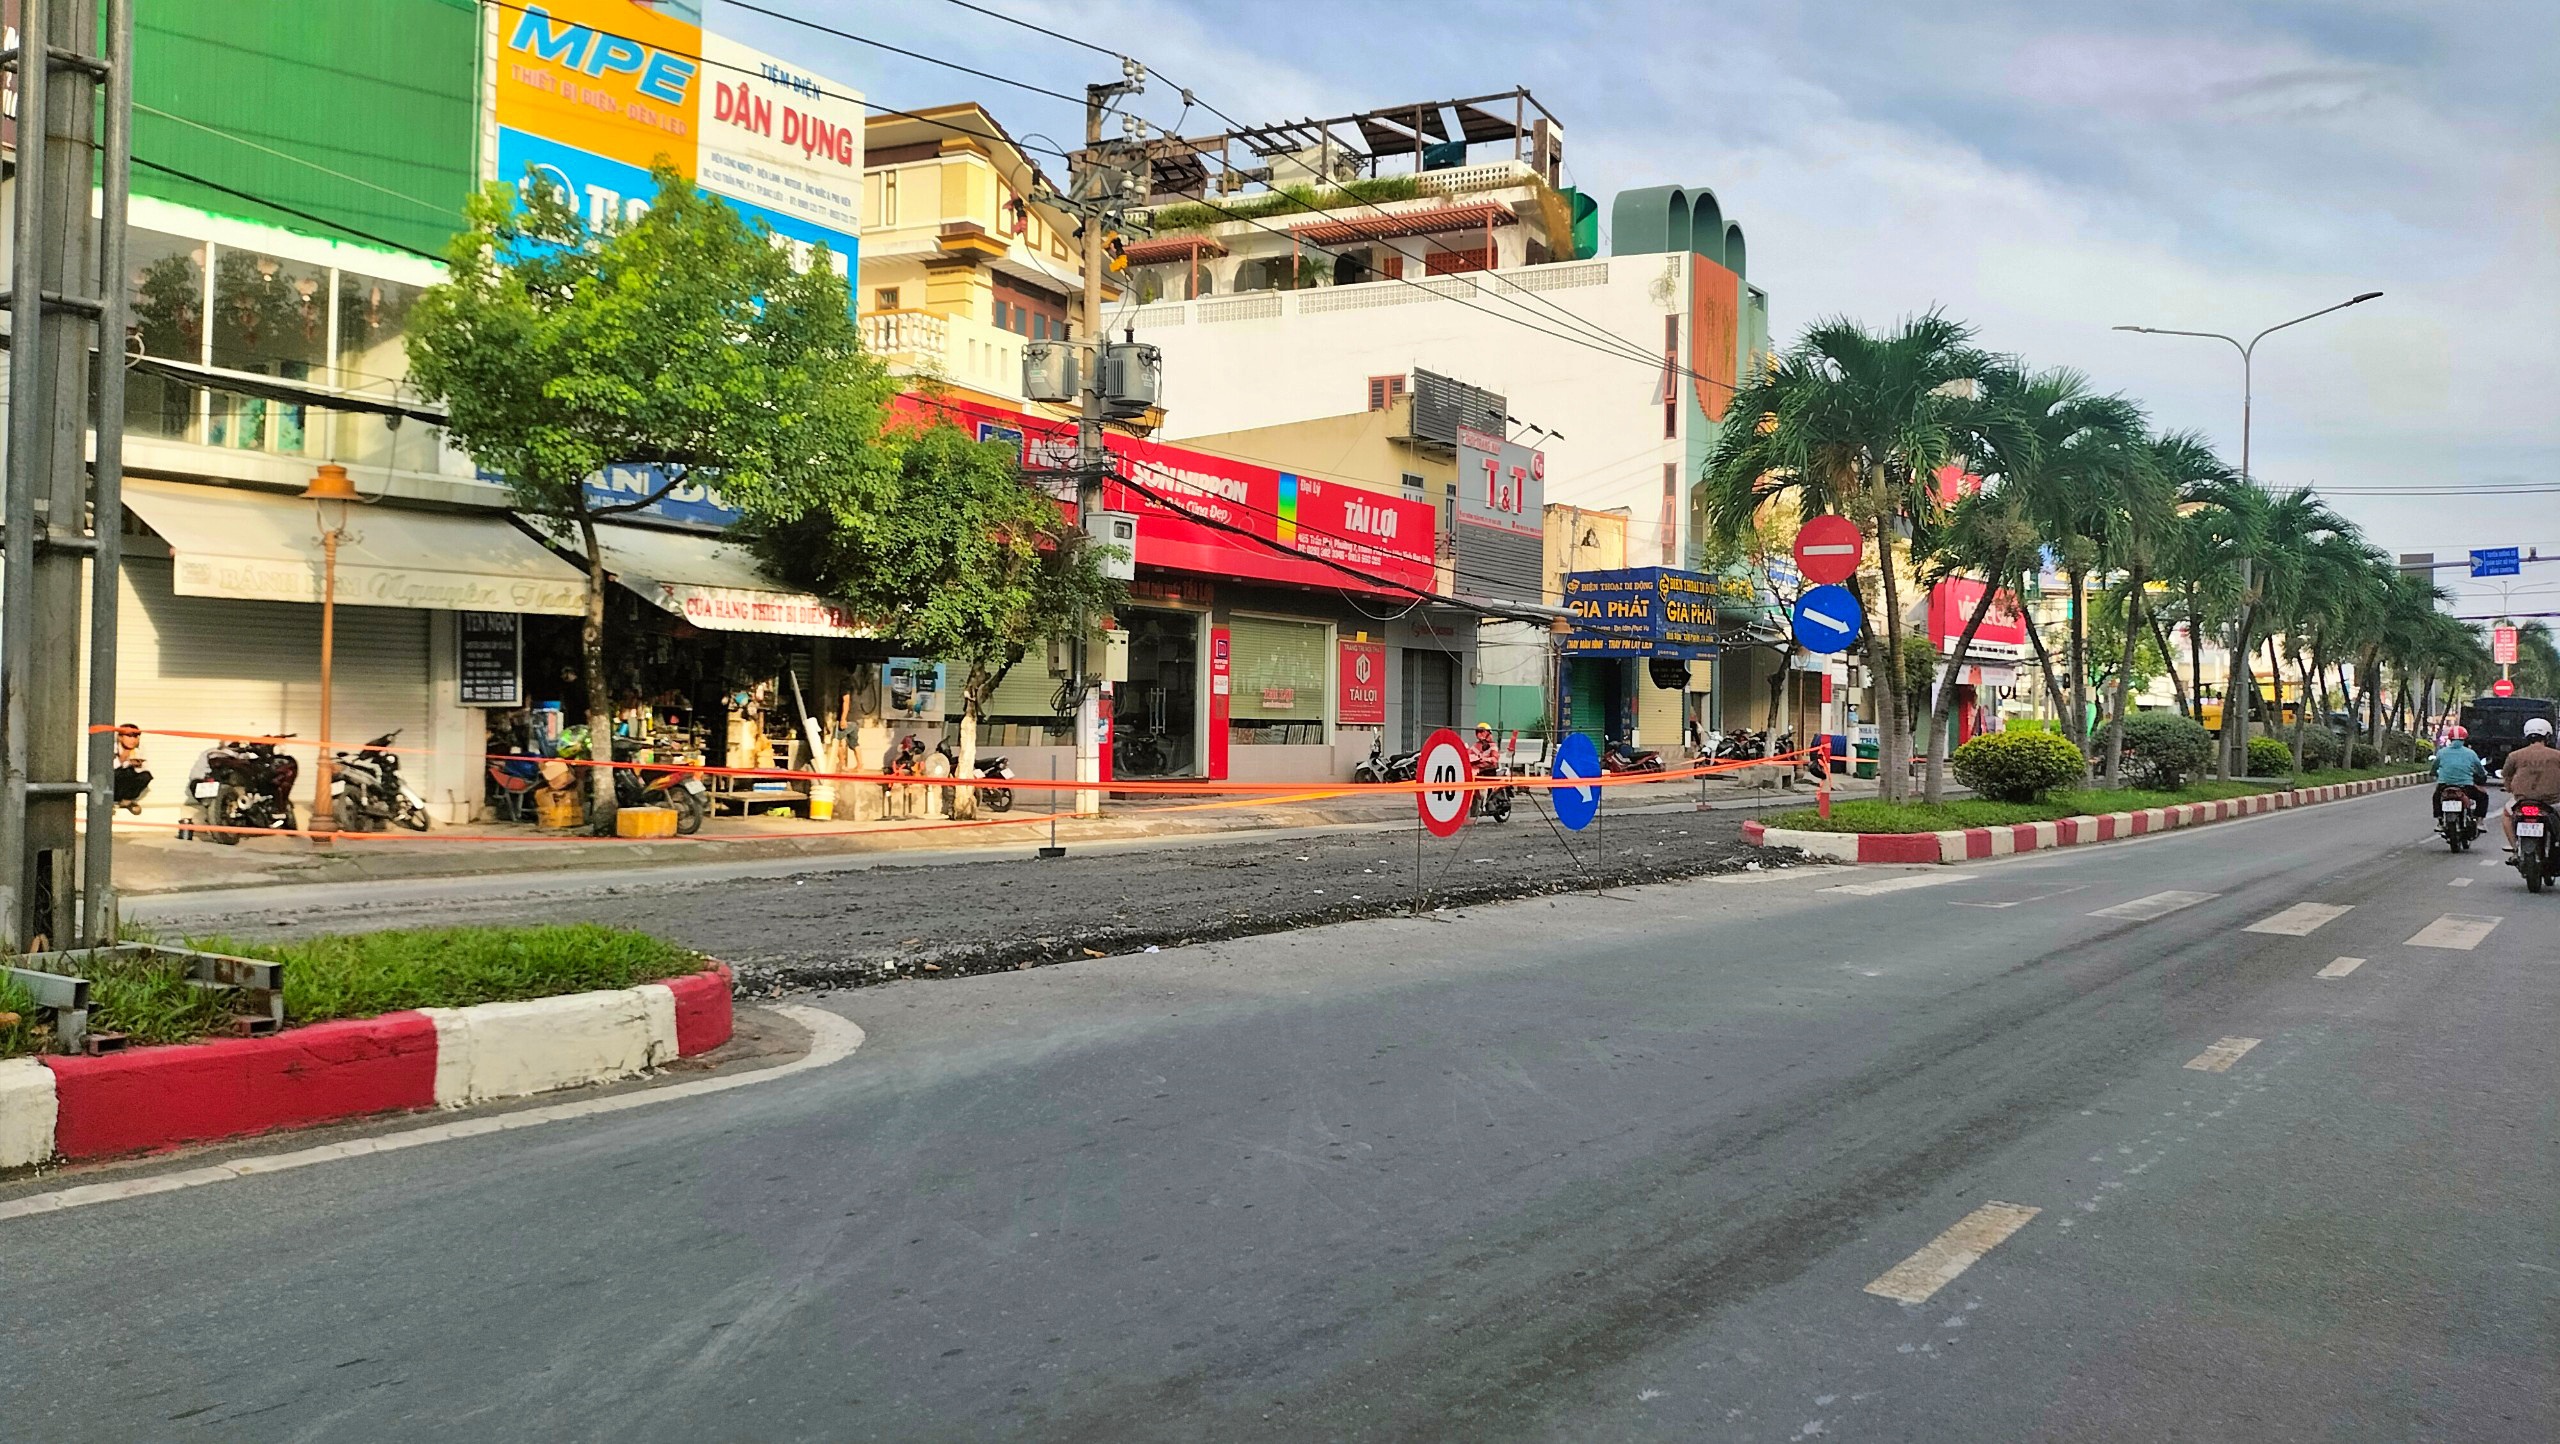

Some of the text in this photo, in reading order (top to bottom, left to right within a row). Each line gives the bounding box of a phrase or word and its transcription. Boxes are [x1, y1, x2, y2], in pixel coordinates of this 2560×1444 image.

[508, 3, 698, 106] MPE
[714, 80, 853, 168] DÂN DỤNG
[1175, 469, 1248, 504] NIPPON
[1371, 507, 1398, 543] LỢI
[1607, 595, 1649, 618] PHÁT
[1667, 599, 1717, 625] GIA PHÁT
[1432, 765, 1456, 802] 40
